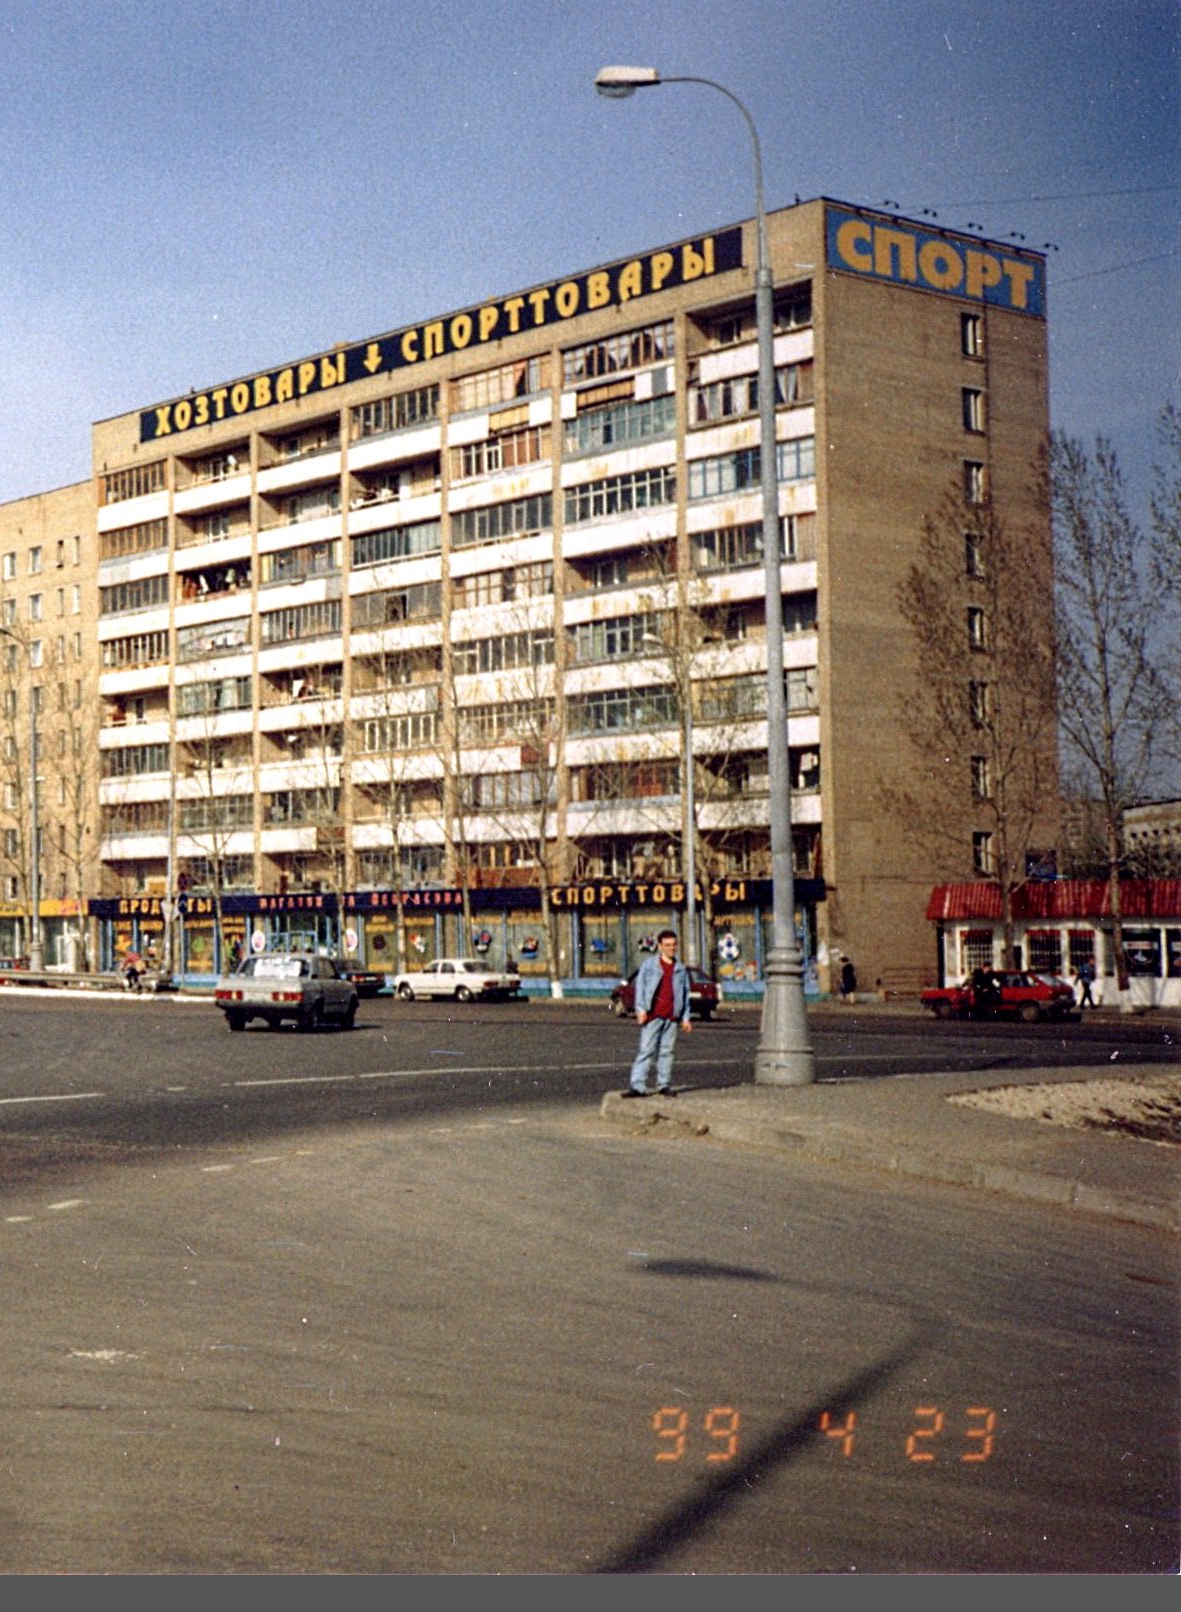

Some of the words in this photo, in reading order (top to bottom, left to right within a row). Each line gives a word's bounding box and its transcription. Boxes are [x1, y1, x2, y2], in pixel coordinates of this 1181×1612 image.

[836, 217, 1037, 312] СПОРТ
[154, 351, 346, 437] ХОЗТОВАРЫ
[400, 236, 716, 363] СПОРТТОВАРЫ
[119, 897, 213, 915] ПРОДТЫ
